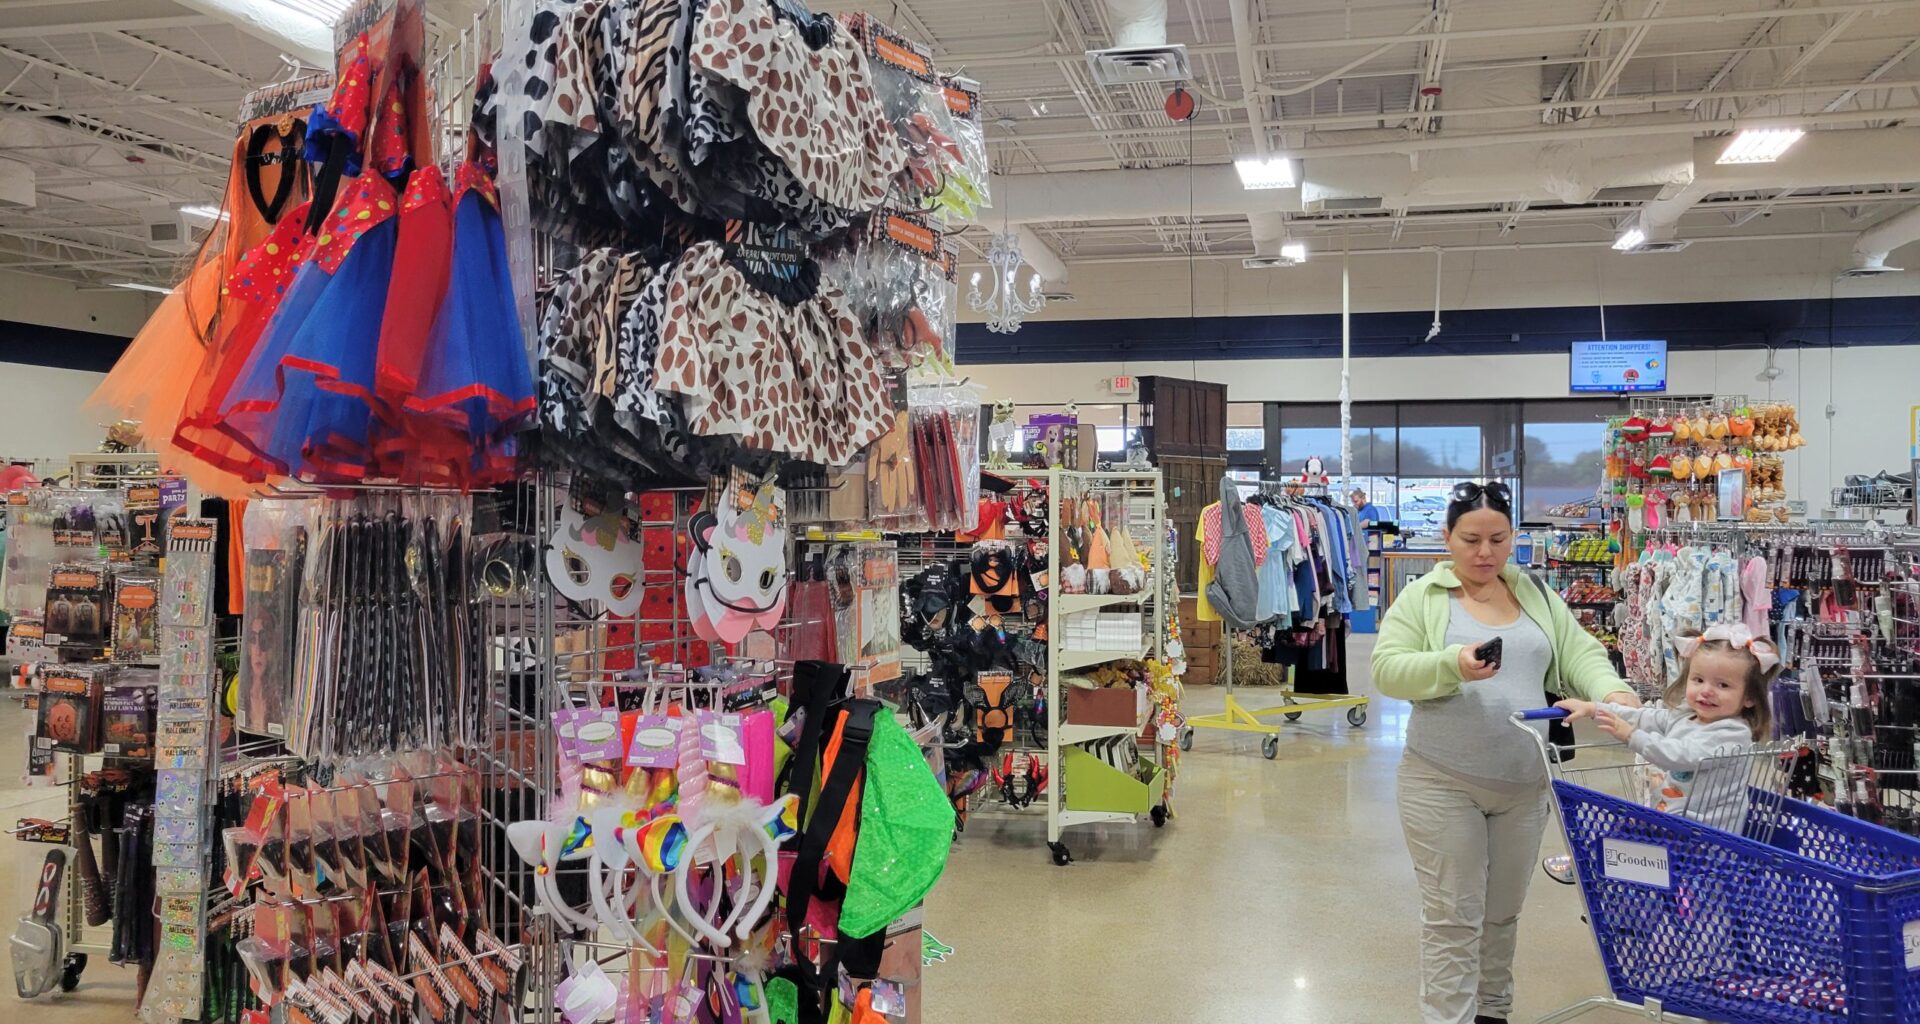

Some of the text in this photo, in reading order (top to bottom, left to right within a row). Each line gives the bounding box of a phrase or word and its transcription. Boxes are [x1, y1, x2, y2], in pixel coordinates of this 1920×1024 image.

[761, 250, 780, 261] RINT
[1587, 343, 1651, 351] ATTENTION SHOPPERS!
[1115, 377, 1130, 388] EXIT
[1617, 852, 1668, 871] Goodwill
